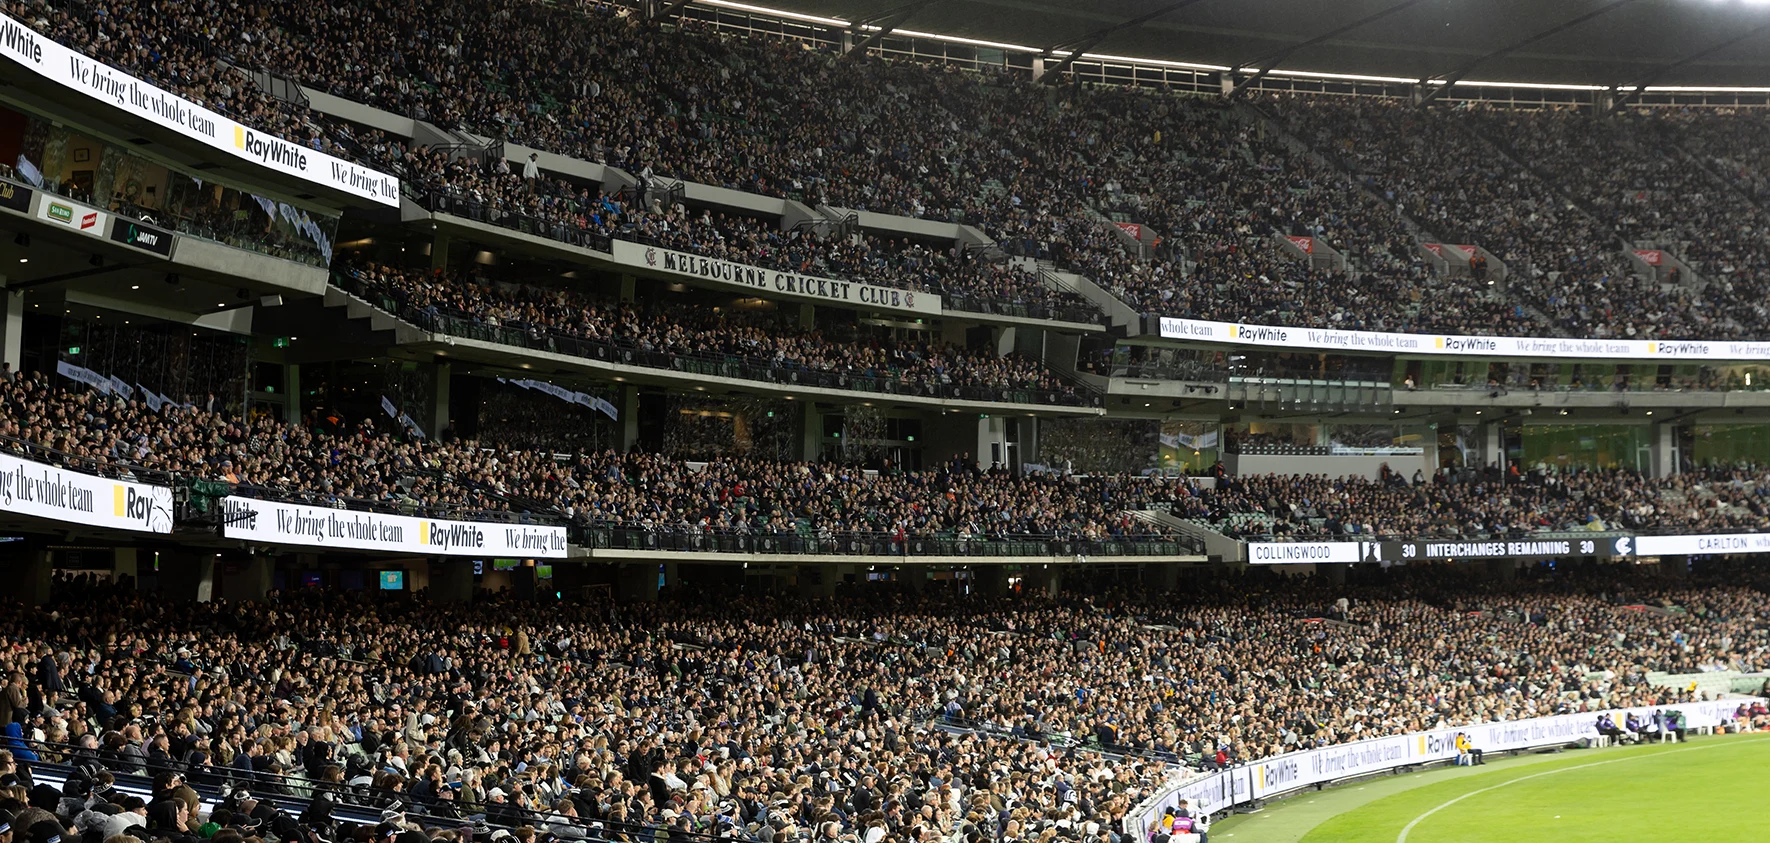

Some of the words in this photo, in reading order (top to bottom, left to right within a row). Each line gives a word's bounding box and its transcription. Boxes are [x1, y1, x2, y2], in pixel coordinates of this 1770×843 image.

[70, 56, 89, 84] We
[92, 65, 126, 105] bring
[130, 82, 148, 110] the
[151, 93, 185, 125] whole
[188, 109, 215, 138] team
[245, 131, 307, 171] RayWhite
[331, 161, 347, 184] We
[350, 166, 379, 197] bring
[381, 177, 397, 200] the
[663, 252, 766, 287] MELBOURNE
[775, 274, 850, 299] CRICKET
[860, 286, 900, 307] CLUB
[1161, 320, 1189, 335] whole
[1190, 323, 1213, 336] team
[1239, 326, 1287, 342] RayWhite
[1307, 331, 1321, 343] We
[1324, 331, 1348, 346] bring
[1351, 333, 1365, 346] the
[1368, 334, 1394, 347] whole
[1396, 337, 1418, 348] team
[1445, 338, 1496, 351] RayWhite
[1516, 340, 1529, 351] We
[1532, 340, 1556, 353] bring
[1559, 341, 1573, 353] the
[1575, 341, 1603, 353] whole
[1606, 343, 1630, 354] team
[1658, 343, 1709, 355] RayWhite
[16, 464, 34, 501] the
[36, 470, 66, 509] whole
[68, 480, 93, 513] team
[127, 487, 153, 526] Ray
[276, 508, 292, 534] We
[295, 509, 325, 542] bring
[328, 512, 345, 538] the
[347, 515, 377, 541] whole
[379, 520, 403, 543] team
[430, 522, 483, 550] RayWhite
[505, 528, 520, 549] We
[522, 528, 548, 554] bring
[550, 530, 565, 551] the
[1402, 543, 1416, 558] 30
[1426, 542, 1505, 557] INTERCHANGES
[1508, 541, 1570, 556] REMAINING
[1580, 540, 1595, 554] 30
[1699, 537, 1748, 550] CARLTON
[1256, 546, 1330, 559] COLLINGWOOD
[1531, 721, 1545, 740] the
[1361, 743, 1382, 764] whole
[1428, 731, 1472, 756] RayWe
